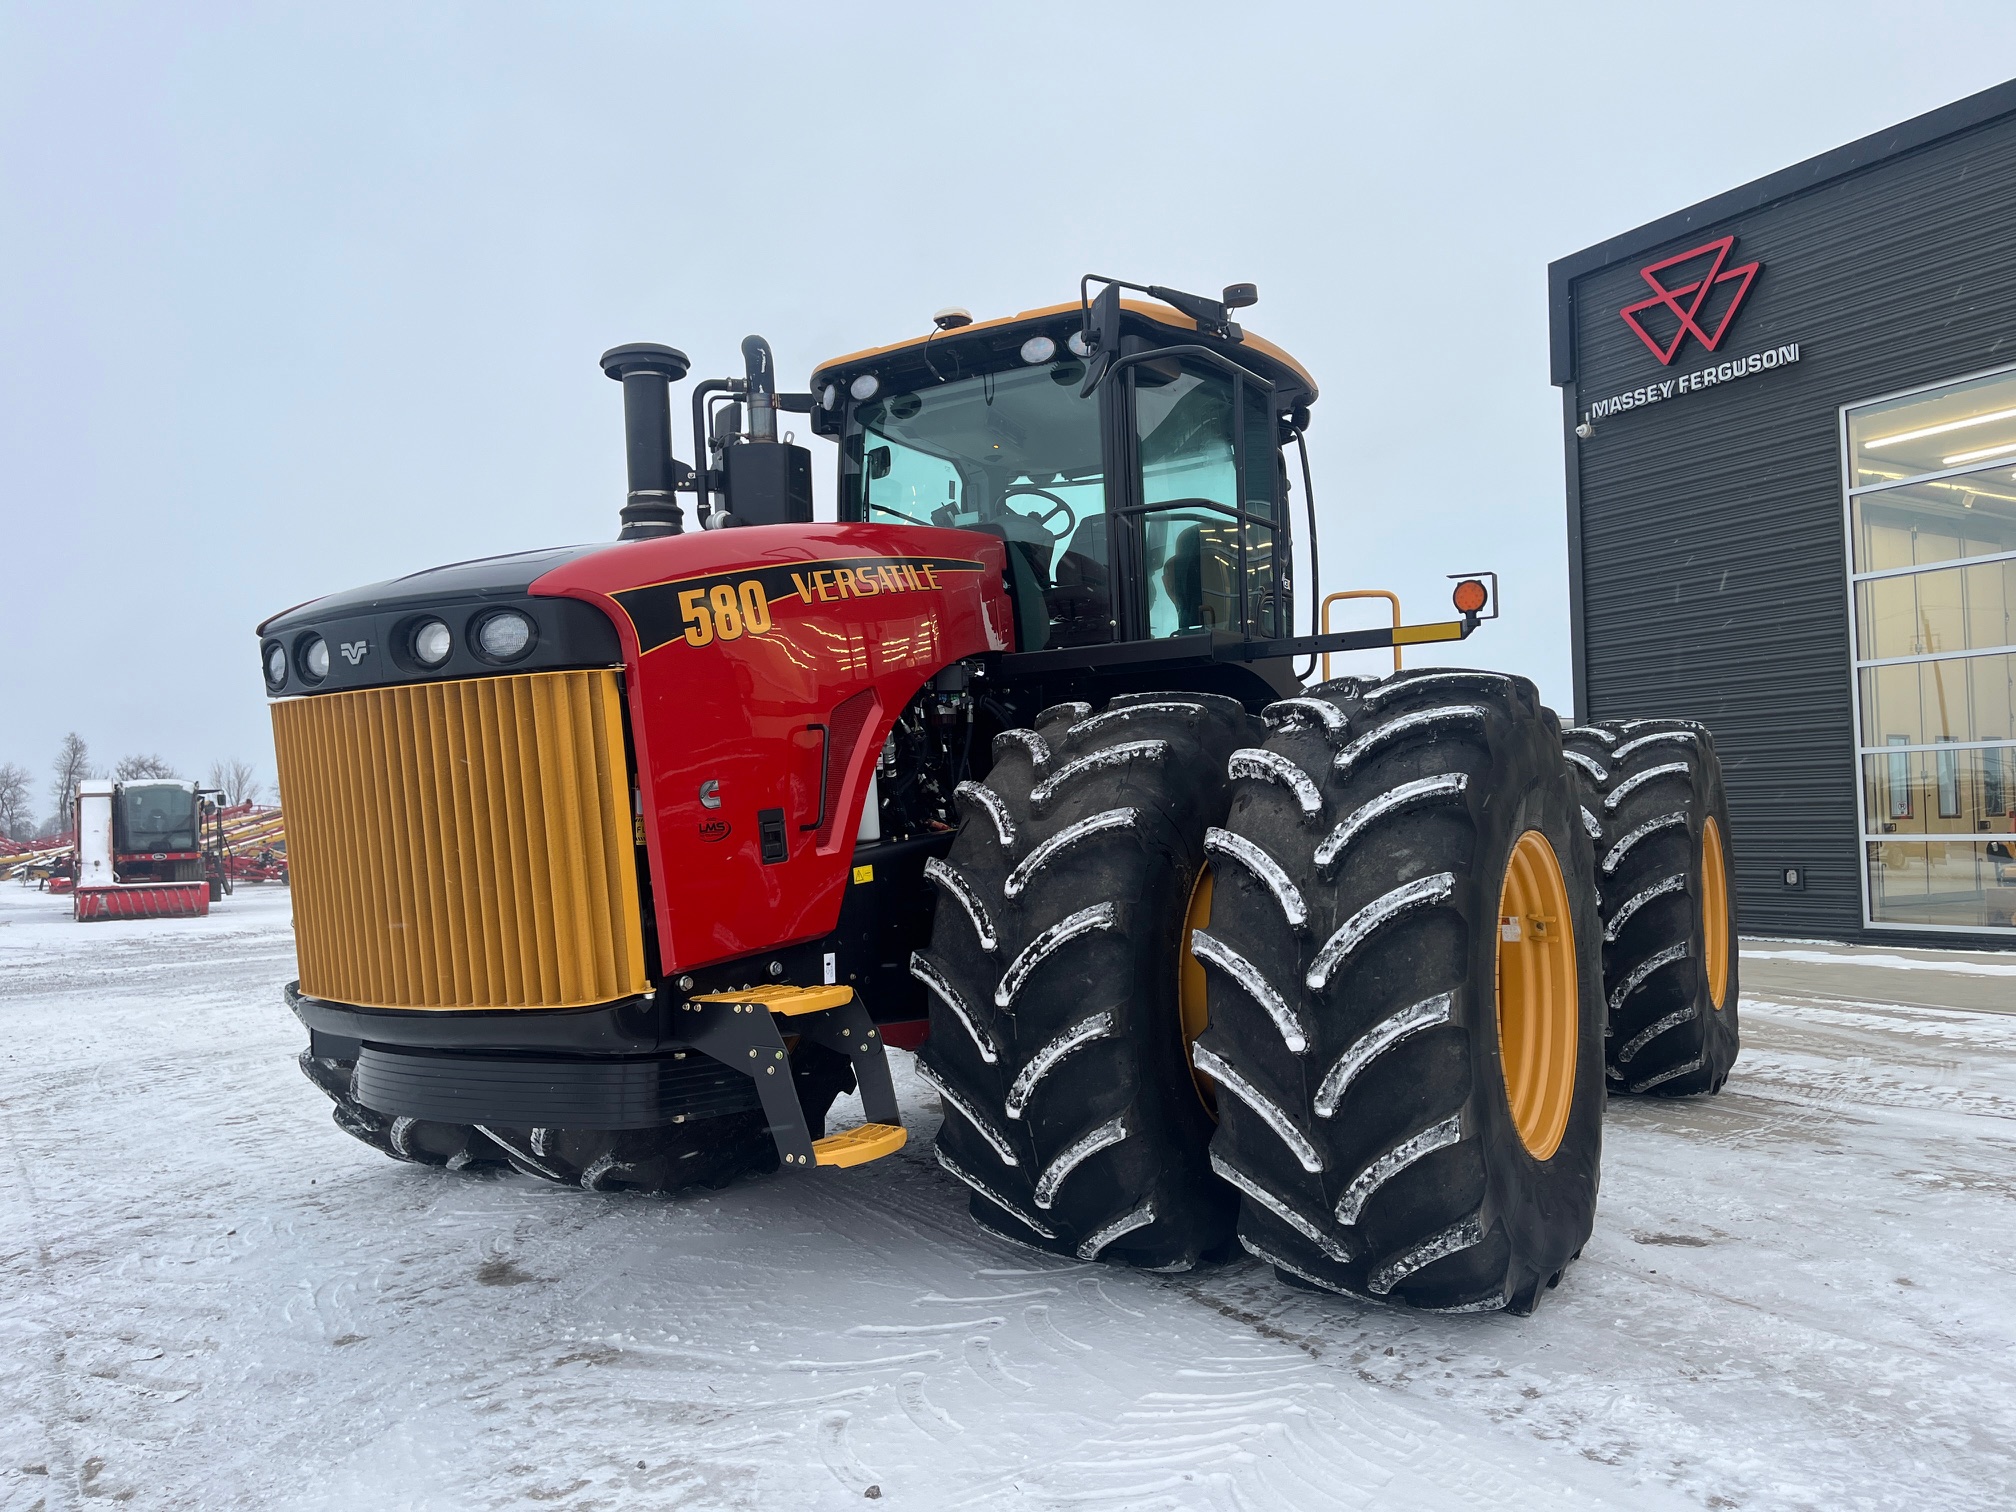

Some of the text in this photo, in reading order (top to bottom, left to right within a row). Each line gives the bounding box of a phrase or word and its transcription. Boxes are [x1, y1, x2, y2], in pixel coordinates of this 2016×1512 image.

[1592, 343, 1799, 418] MASSEY FERGUSON
[678, 564, 942, 647] 580 VERSATILE
[699, 822, 725, 833] LMS
